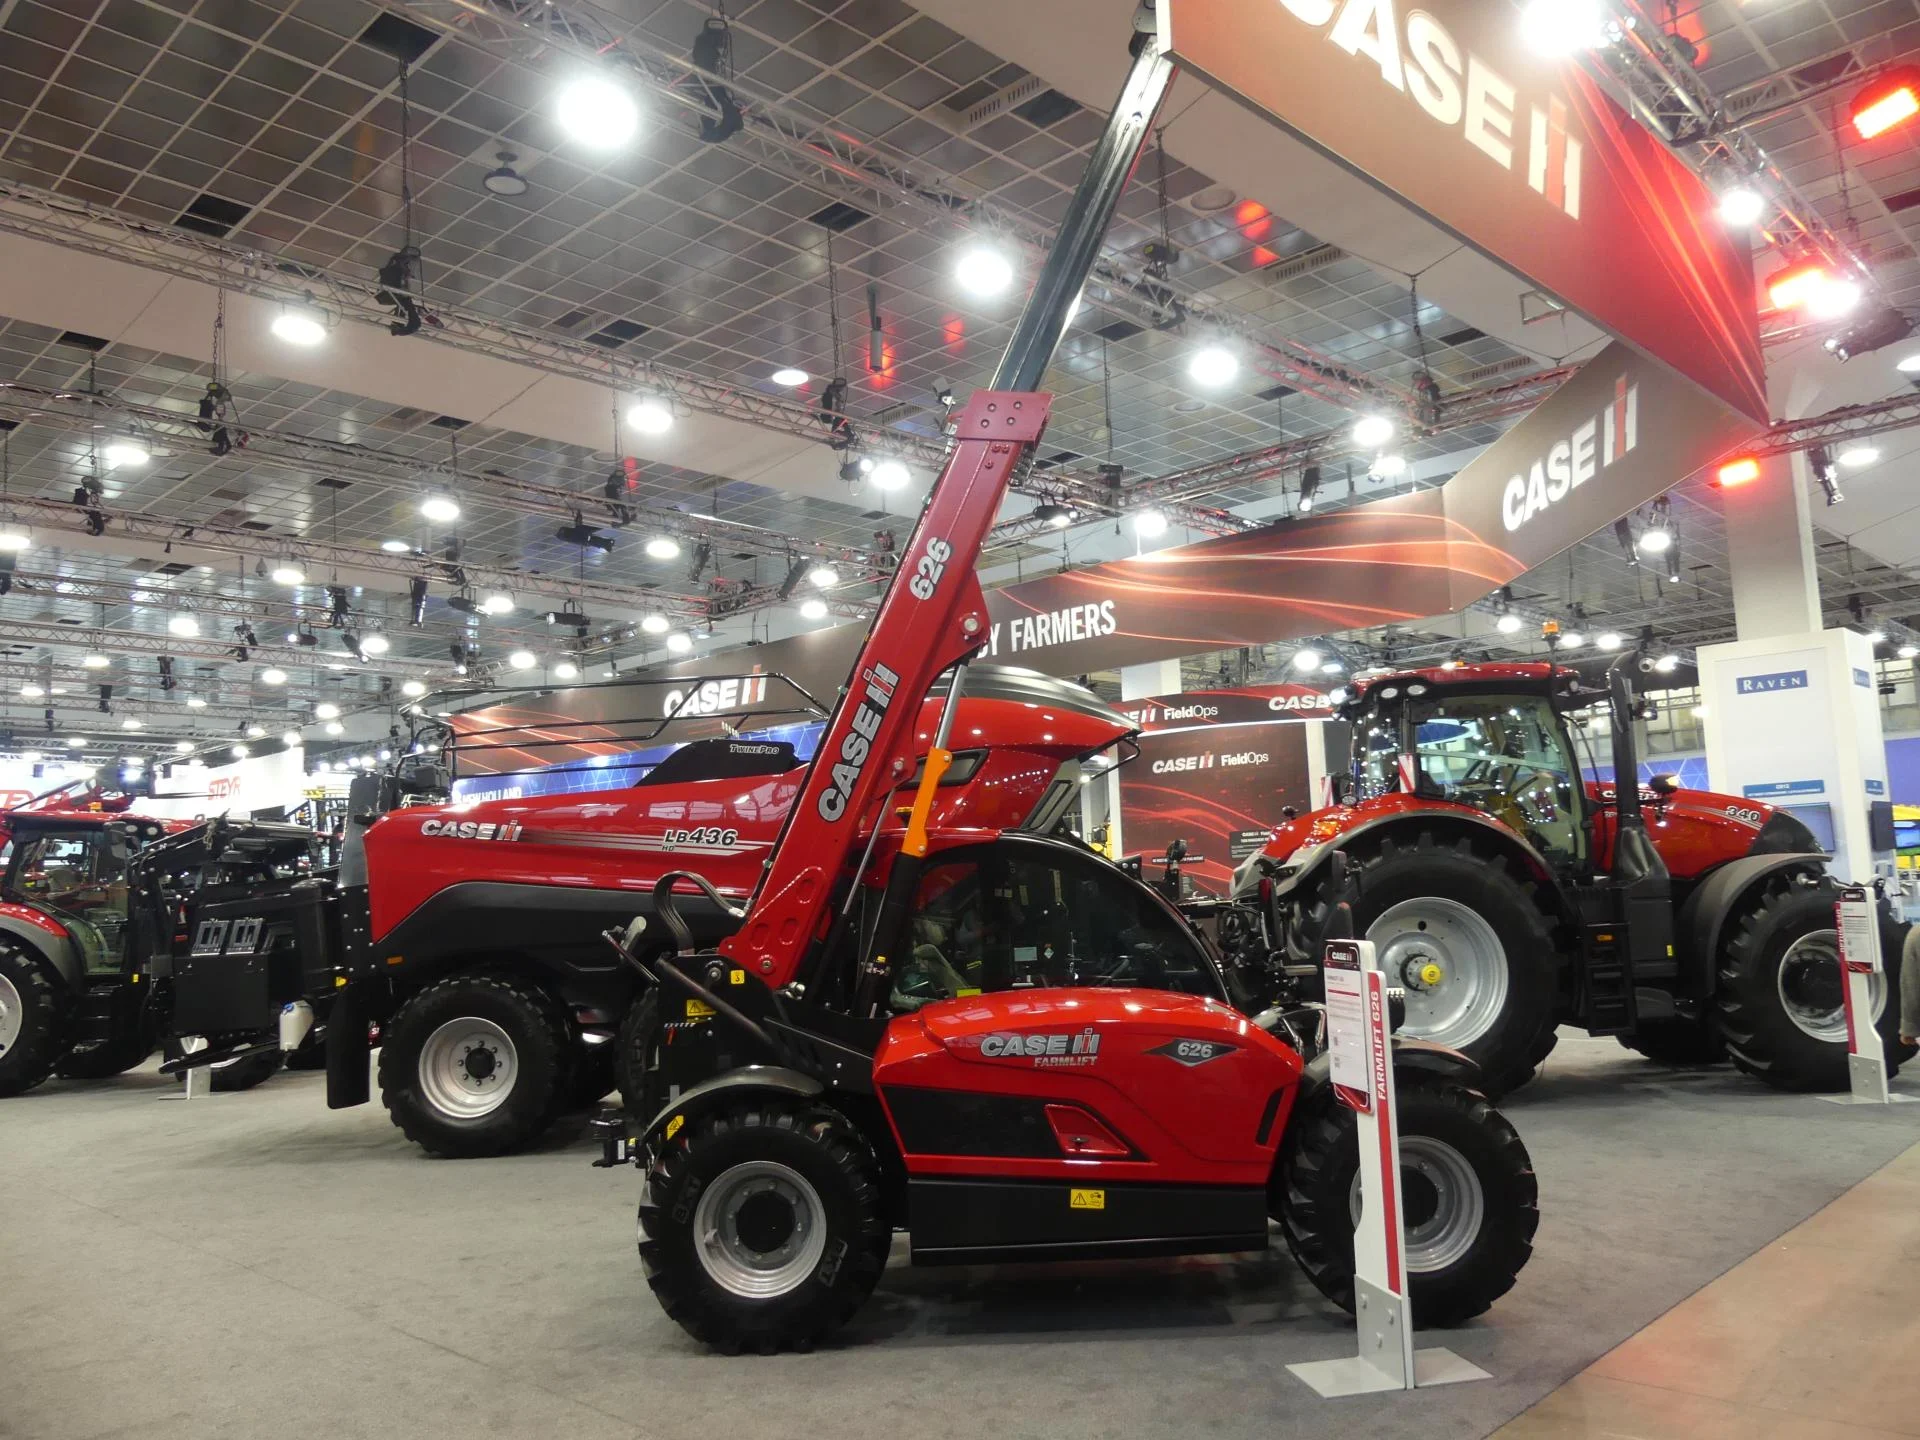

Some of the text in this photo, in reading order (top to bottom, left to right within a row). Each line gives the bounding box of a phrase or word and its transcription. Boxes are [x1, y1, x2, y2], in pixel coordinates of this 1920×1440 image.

[1503, 413, 1597, 532] CASE
[909, 537, 950, 600] 626
[1011, 600, 1116, 652] FARMERS
[1743, 677, 1800, 691] RAVEN
[663, 679, 739, 719] CASE
[1163, 705, 1218, 721] FieldOps
[818, 702, 883, 822] CASE
[1152, 756, 1198, 774] CASE
[1221, 752, 1269, 767] FieldOps
[208, 776, 241, 801] STEYR
[1726, 805, 1760, 822] 340
[421, 819, 497, 841] CASE
[1332, 951, 1347, 961] CASE
[980, 1034, 1069, 1057] CASE
[1177, 1041, 1213, 1058] 626
[1371, 991, 1386, 1100] FARMLIFT 626
[1034, 1056, 1098, 1068] FARMLIFT
